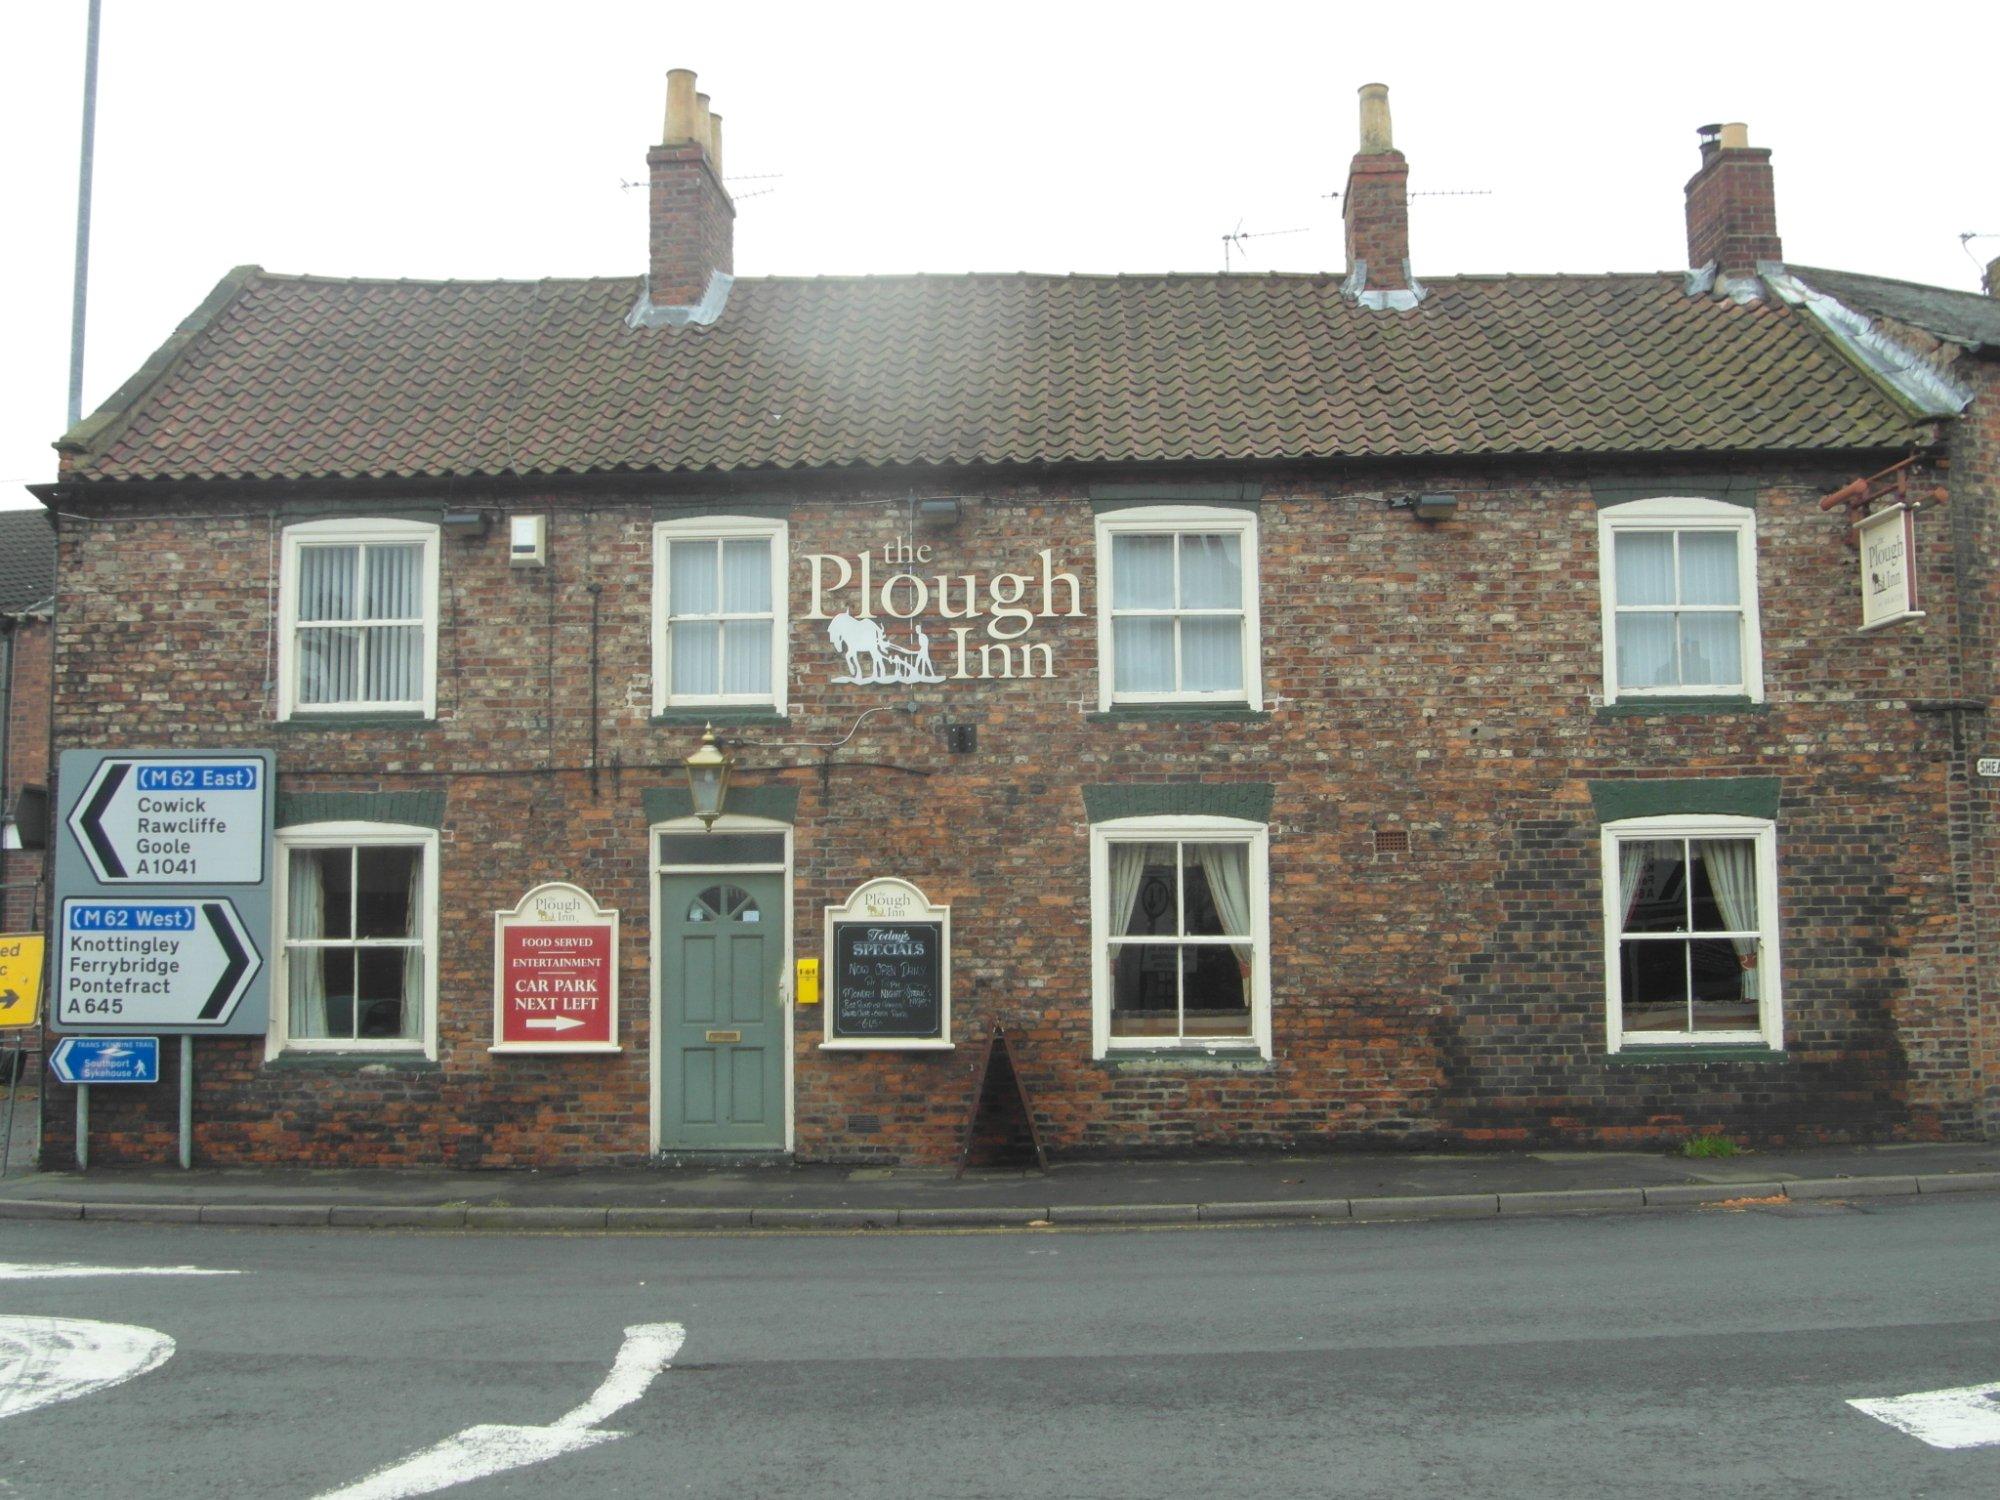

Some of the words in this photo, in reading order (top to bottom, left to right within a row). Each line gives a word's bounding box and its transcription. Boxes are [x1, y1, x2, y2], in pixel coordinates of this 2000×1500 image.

[883, 536, 932, 564] the
[1869, 535, 1904, 567] Plough
[801, 549, 1087, 640] Plough
[949, 627, 1058, 679] Inn
[202, 769, 254, 788] East)
[137, 797, 206, 814] Cowick
[137, 818, 226, 834] Rawcliffe
[137, 838, 191, 855] Goole
[136, 859, 197, 875] A1041
[536, 898, 581, 914] Plough
[865, 892, 911, 909] Plough
[136, 909, 193, 928] West)
[557, 912, 575, 922] Inn
[887, 907, 905, 917] Inn
[70, 936, 180, 955] Knottingley
[522, 937, 552, 947] FOOD
[554, 937, 593, 947] SERVED
[852, 943, 925, 956] SPECIALS
[70, 957, 180, 976] Ferrybridge
[512, 958, 602, 968] ENTERTAINMENT
[69, 977, 171, 994] Pontefract
[515, 979, 549, 992] CAR
[554, 979, 598, 992] PARK
[515, 997, 558, 1010] NEXT
[563, 997, 600, 1010] LEFT
[84, 1058, 130, 1069] Southport
[84, 1068, 132, 1079] Sykehouse
